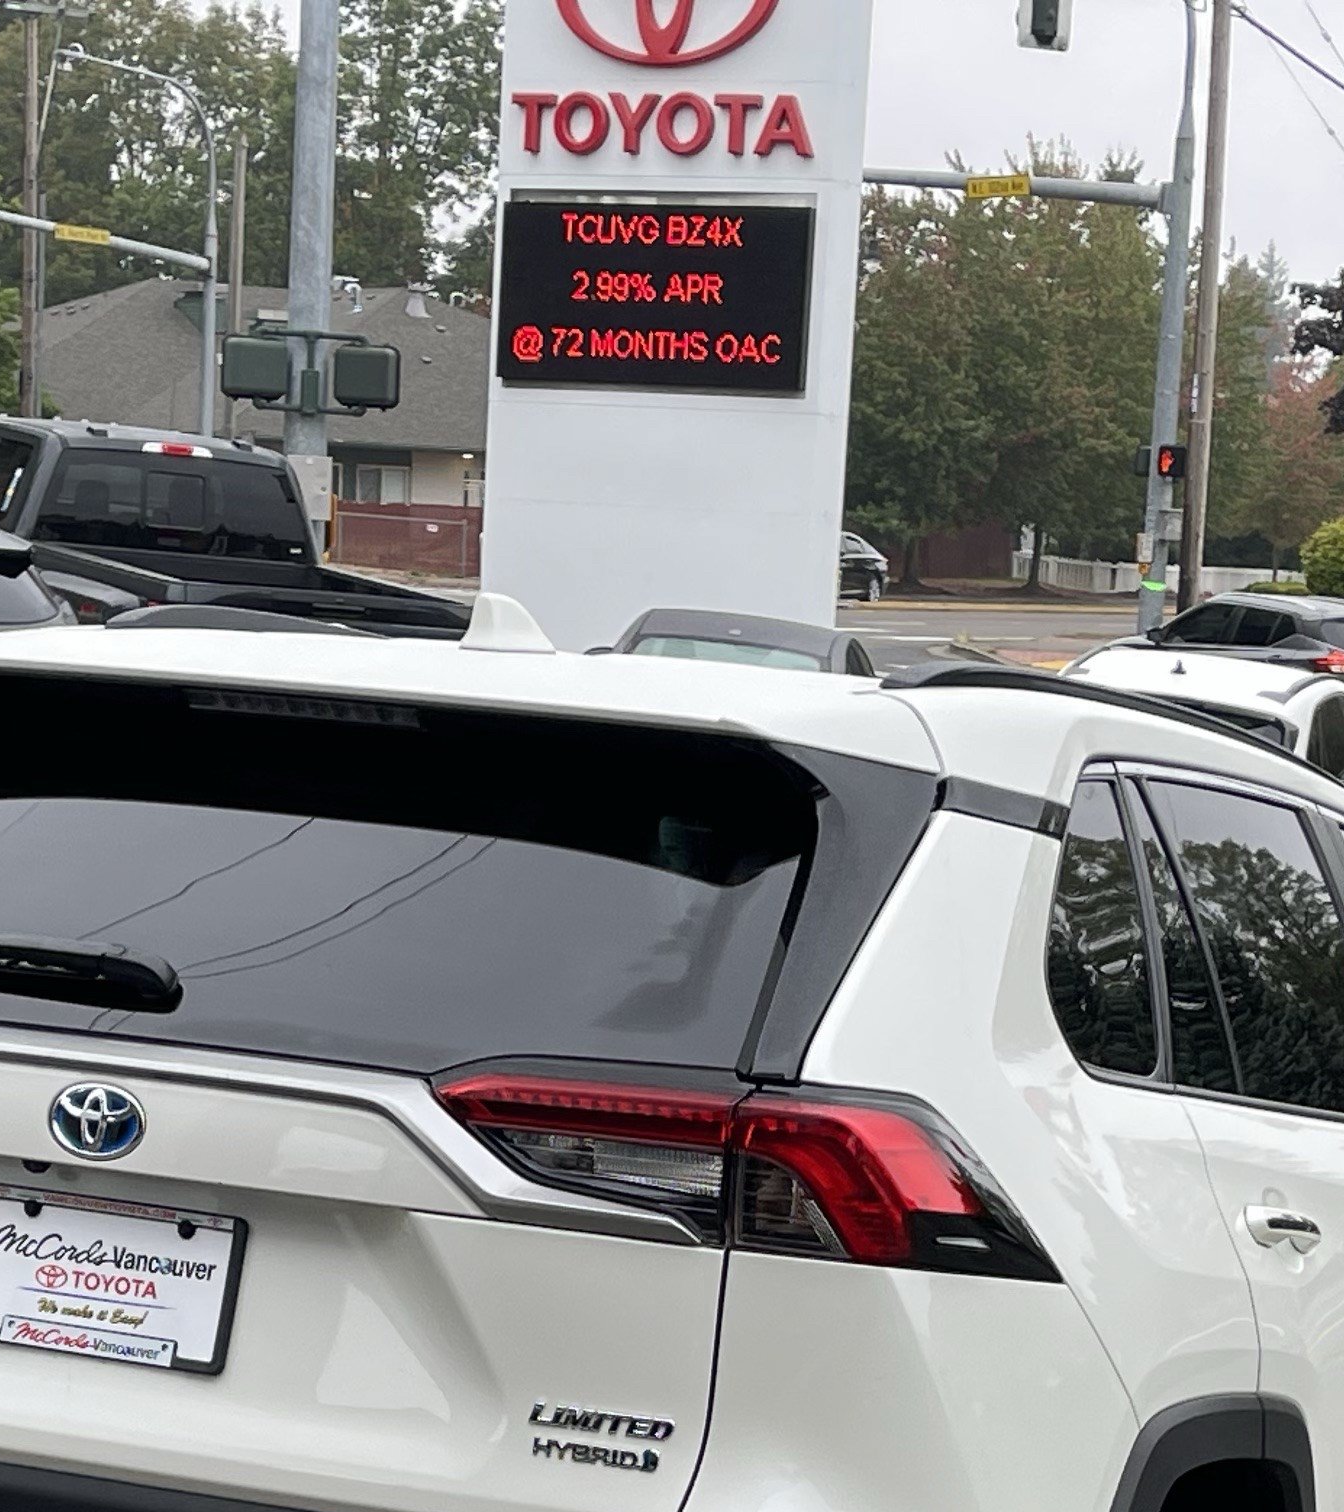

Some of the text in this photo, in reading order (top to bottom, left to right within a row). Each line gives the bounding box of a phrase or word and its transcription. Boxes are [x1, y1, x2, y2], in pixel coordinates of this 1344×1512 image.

[512, 91, 814, 158] TOYOTA
[561, 212, 744, 247] TCUVG BZ4X
[570, 270, 724, 305] 2.99% APR
[512, 325, 782, 364] @ 72 MONTHS OAC
[72, 1269, 158, 1300] TOYOTA
[528, 1400, 676, 1442] LIMITED
[532, 1437, 640, 1470] HYBRID
